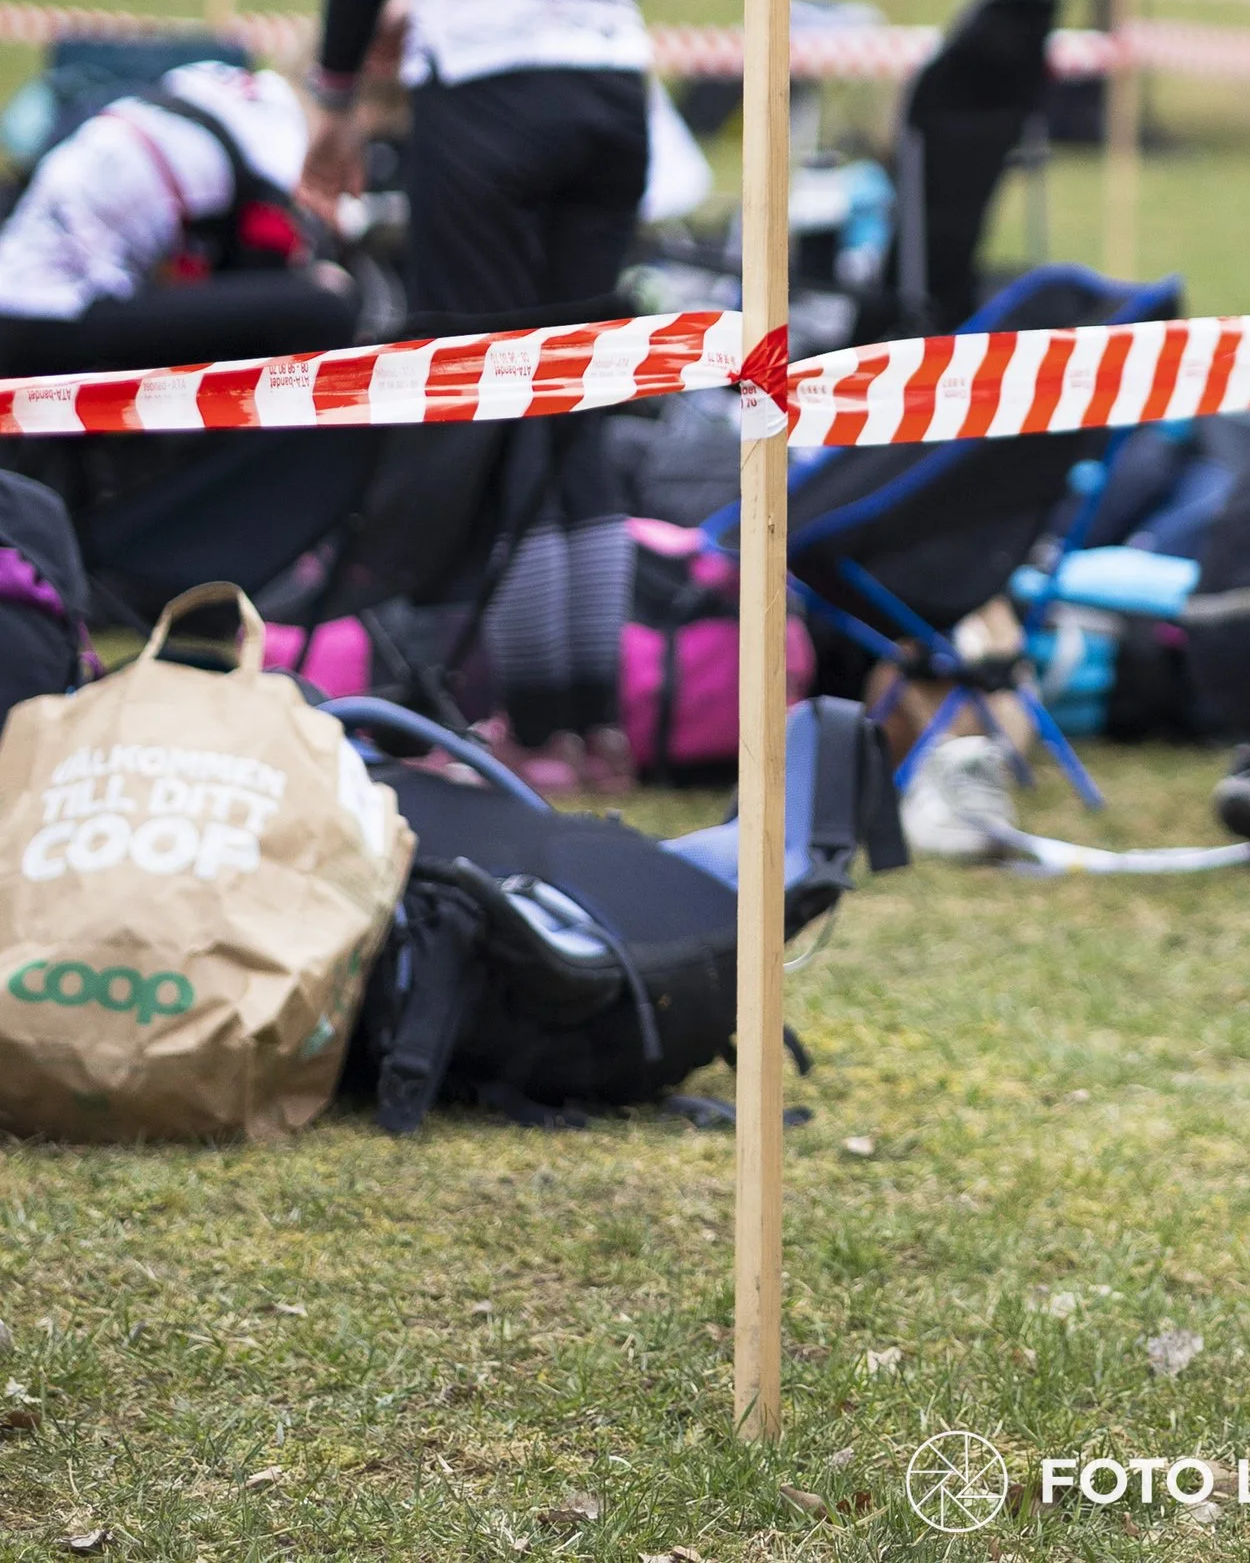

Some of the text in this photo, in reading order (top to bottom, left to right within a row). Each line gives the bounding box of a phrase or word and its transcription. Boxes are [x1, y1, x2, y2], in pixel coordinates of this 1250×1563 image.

[27, 389, 71, 402] ATA-bandet
[269, 376, 309, 388] ATA-bandet
[42, 775, 279, 834] TILL DITT
[8, 959, 195, 1025] coop
